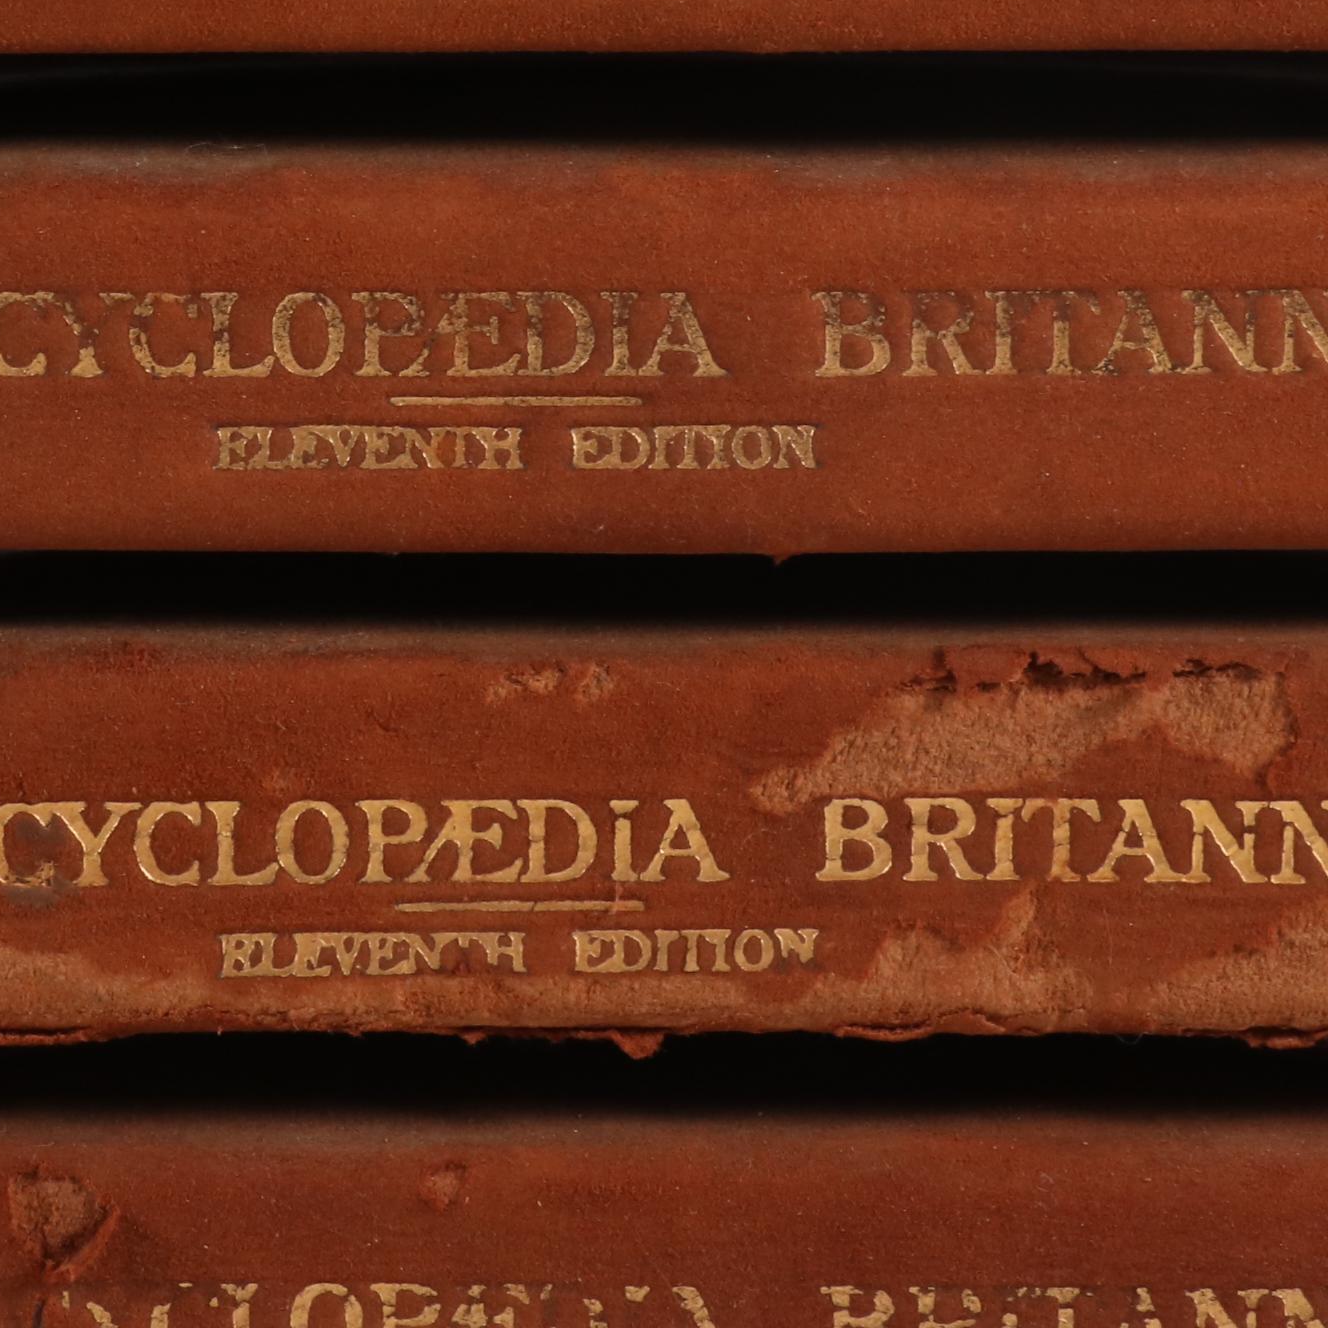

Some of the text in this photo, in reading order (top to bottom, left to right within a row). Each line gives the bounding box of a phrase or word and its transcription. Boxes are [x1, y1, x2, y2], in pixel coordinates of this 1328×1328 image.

[213, 425, 815, 470] ELEVENTH EDITION
[220, 928, 819, 977] ELEVENTH EDITION
